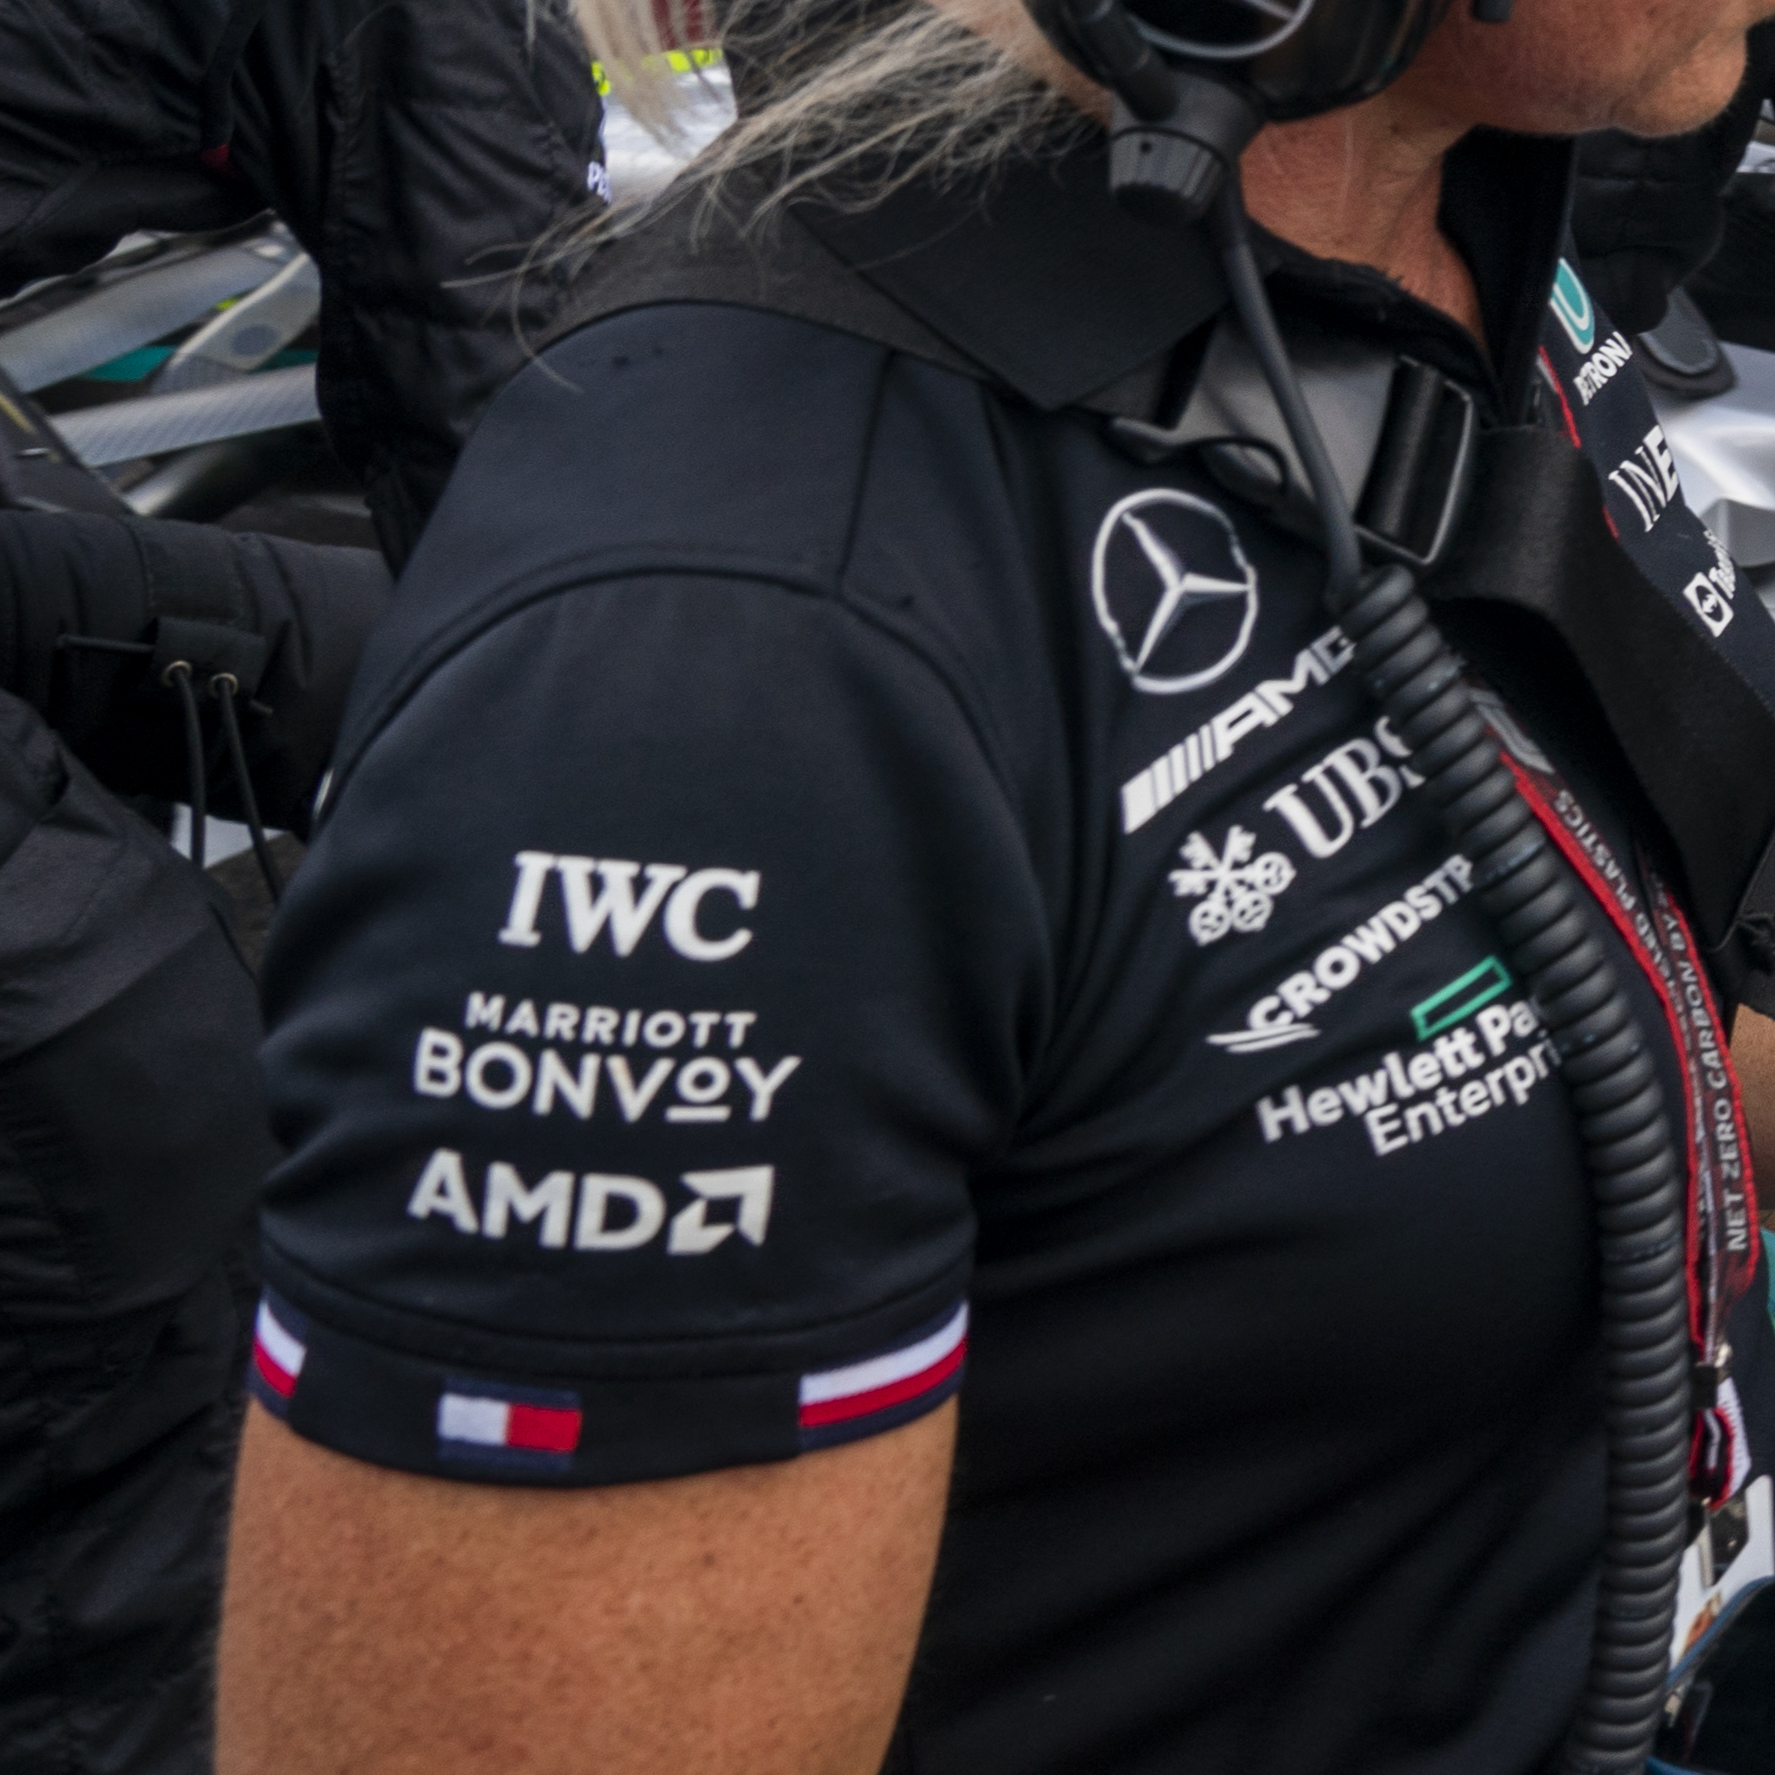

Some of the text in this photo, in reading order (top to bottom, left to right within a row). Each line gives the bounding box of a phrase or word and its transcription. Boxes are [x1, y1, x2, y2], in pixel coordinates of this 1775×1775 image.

[498, 849, 761, 961] IWC
[465, 991, 757, 1049] MARRIOTT
[1678, 959, 1728, 1090] CARBON
[412, 1026, 802, 1124] BONVOY
[1254, 1032, 1486, 1143] Hewlett
[1711, 1096, 1742, 1180] ZERO
[407, 1147, 666, 1251] AMD
[1722, 1190, 1748, 1253] NET
